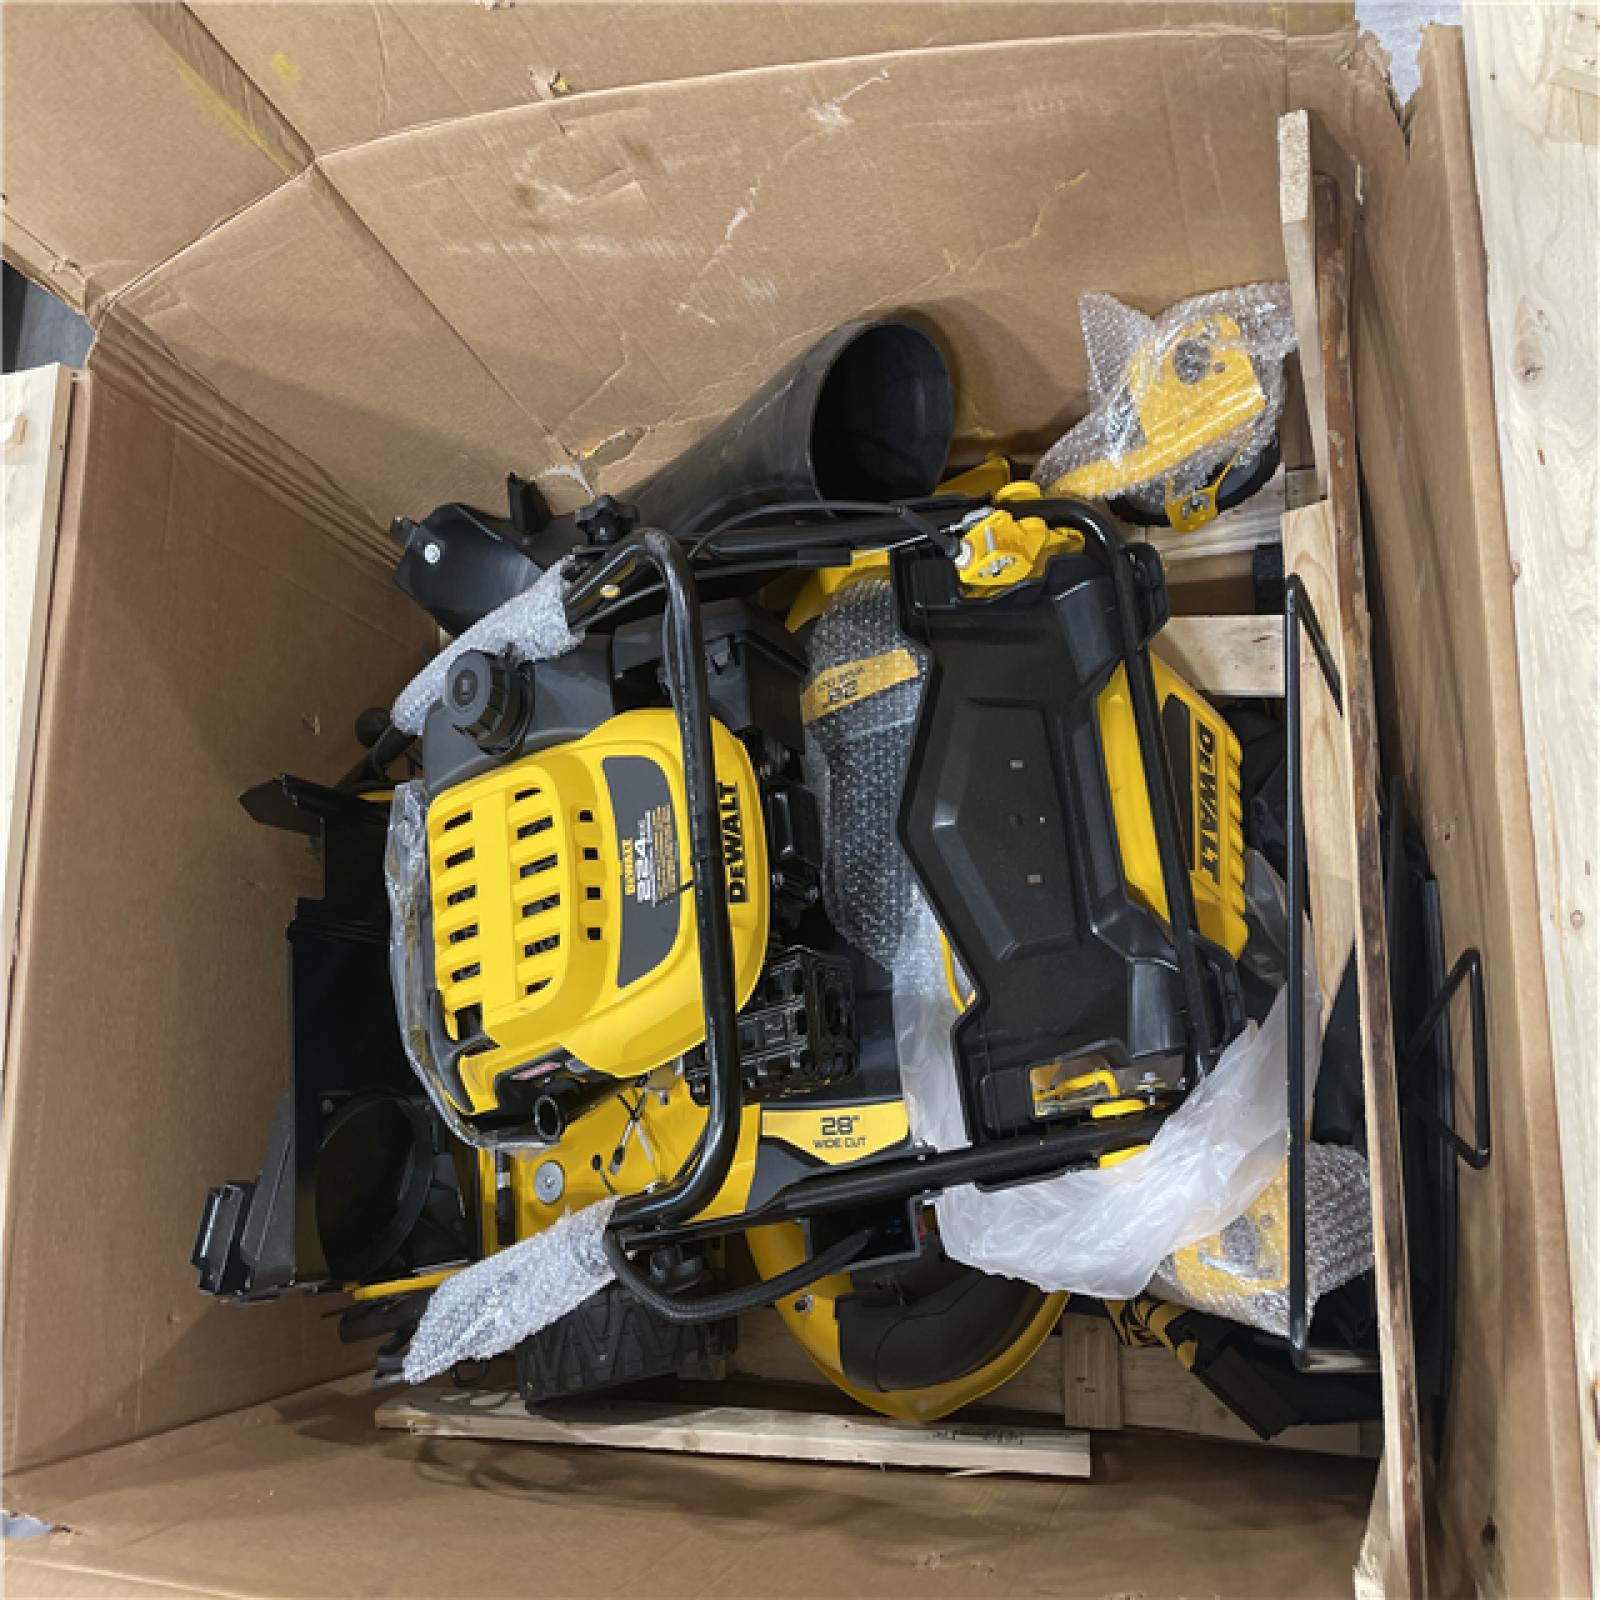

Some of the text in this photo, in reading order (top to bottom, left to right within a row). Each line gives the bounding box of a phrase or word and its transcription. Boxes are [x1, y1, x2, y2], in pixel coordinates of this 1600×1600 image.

[1198, 720, 1220, 886] DEWALT
[717, 781, 747, 903] DEWALT
[813, 1136, 866, 1149] WIDE CUT
[821, 1115, 860, 1136] 28"
